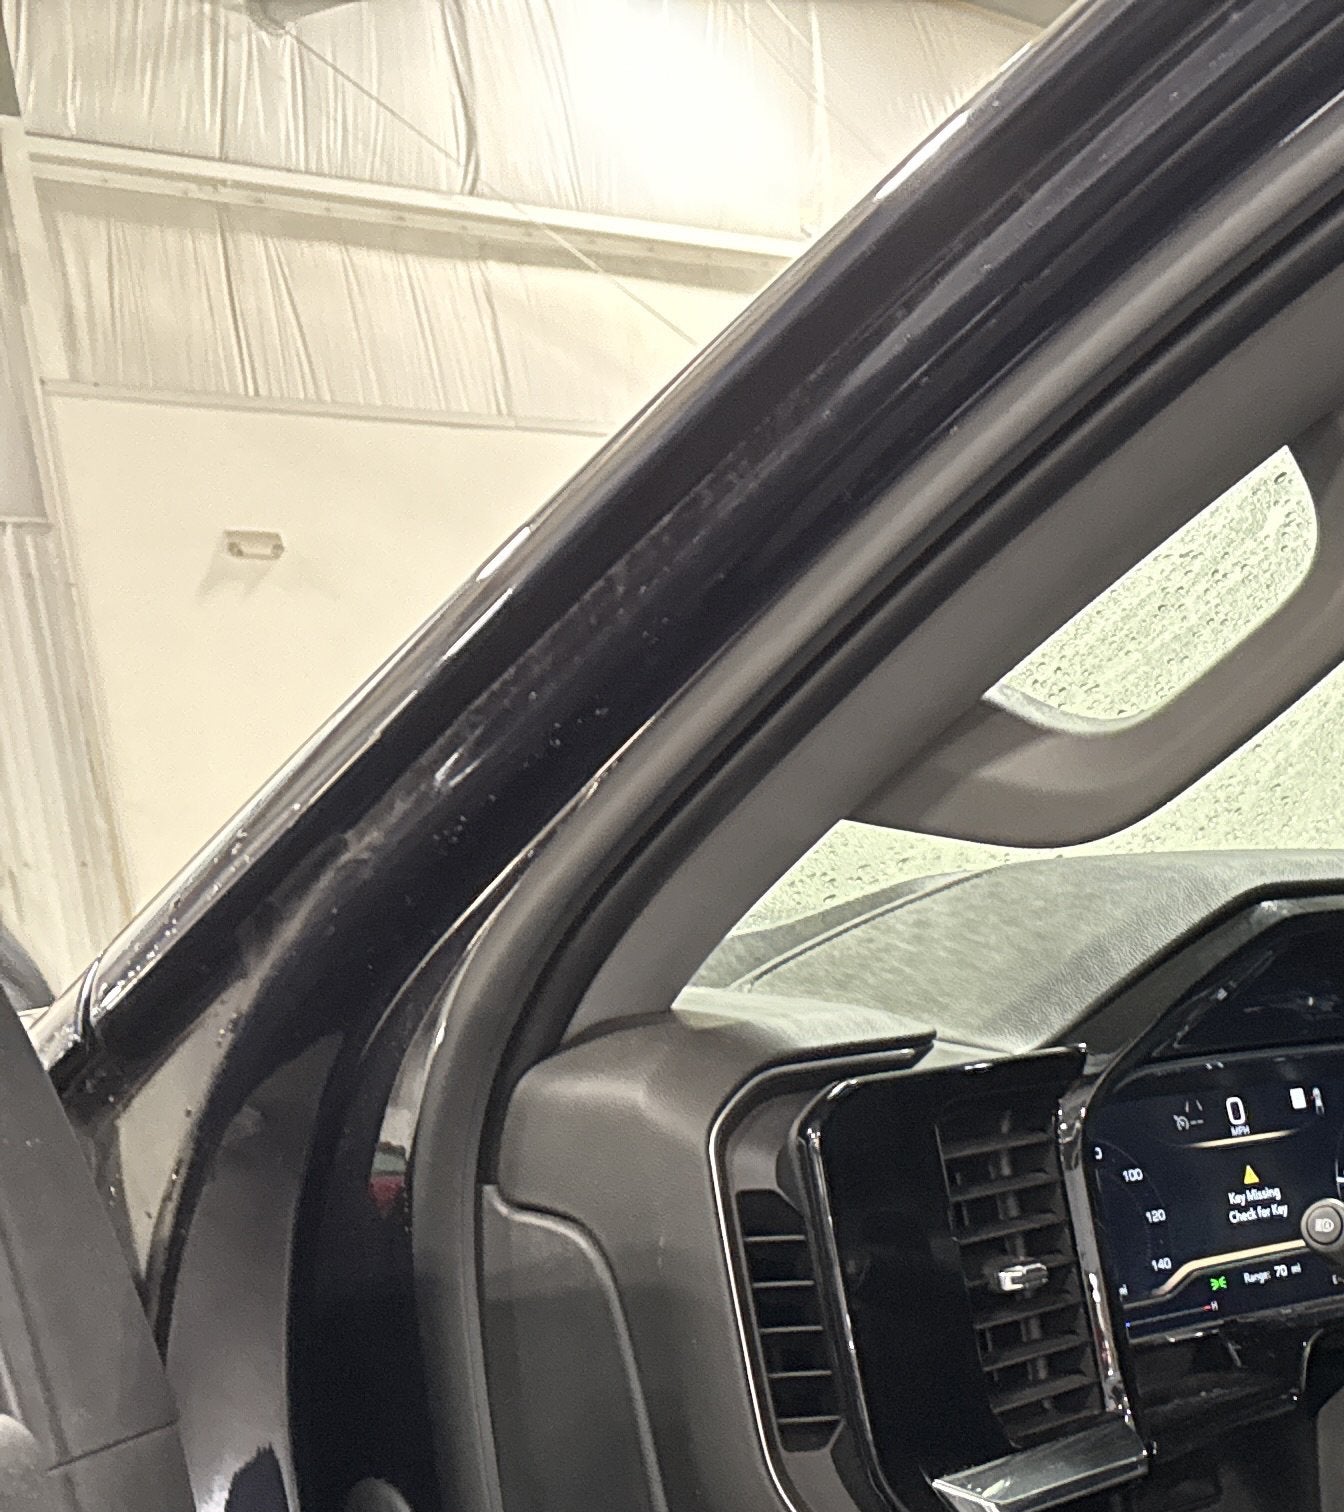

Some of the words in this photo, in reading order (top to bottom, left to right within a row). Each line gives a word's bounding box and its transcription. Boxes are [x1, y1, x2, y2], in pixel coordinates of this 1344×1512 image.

[1226, 1096, 1247, 1125] 0
[1230, 1124, 1251, 1137] MPH
[1122, 1168, 1144, 1183] 100
[1227, 1191, 1246, 1206] Key
[1245, 1187, 1282, 1202] Missing
[1145, 1208, 1166, 1224] 120
[1228, 1206, 1258, 1224] Check
[1257, 1205, 1271, 1218] for
[1270, 1203, 1288, 1218] Key
[1152, 1257, 1172, 1272] 140
[1273, 1264, 1288, 1278] 70
